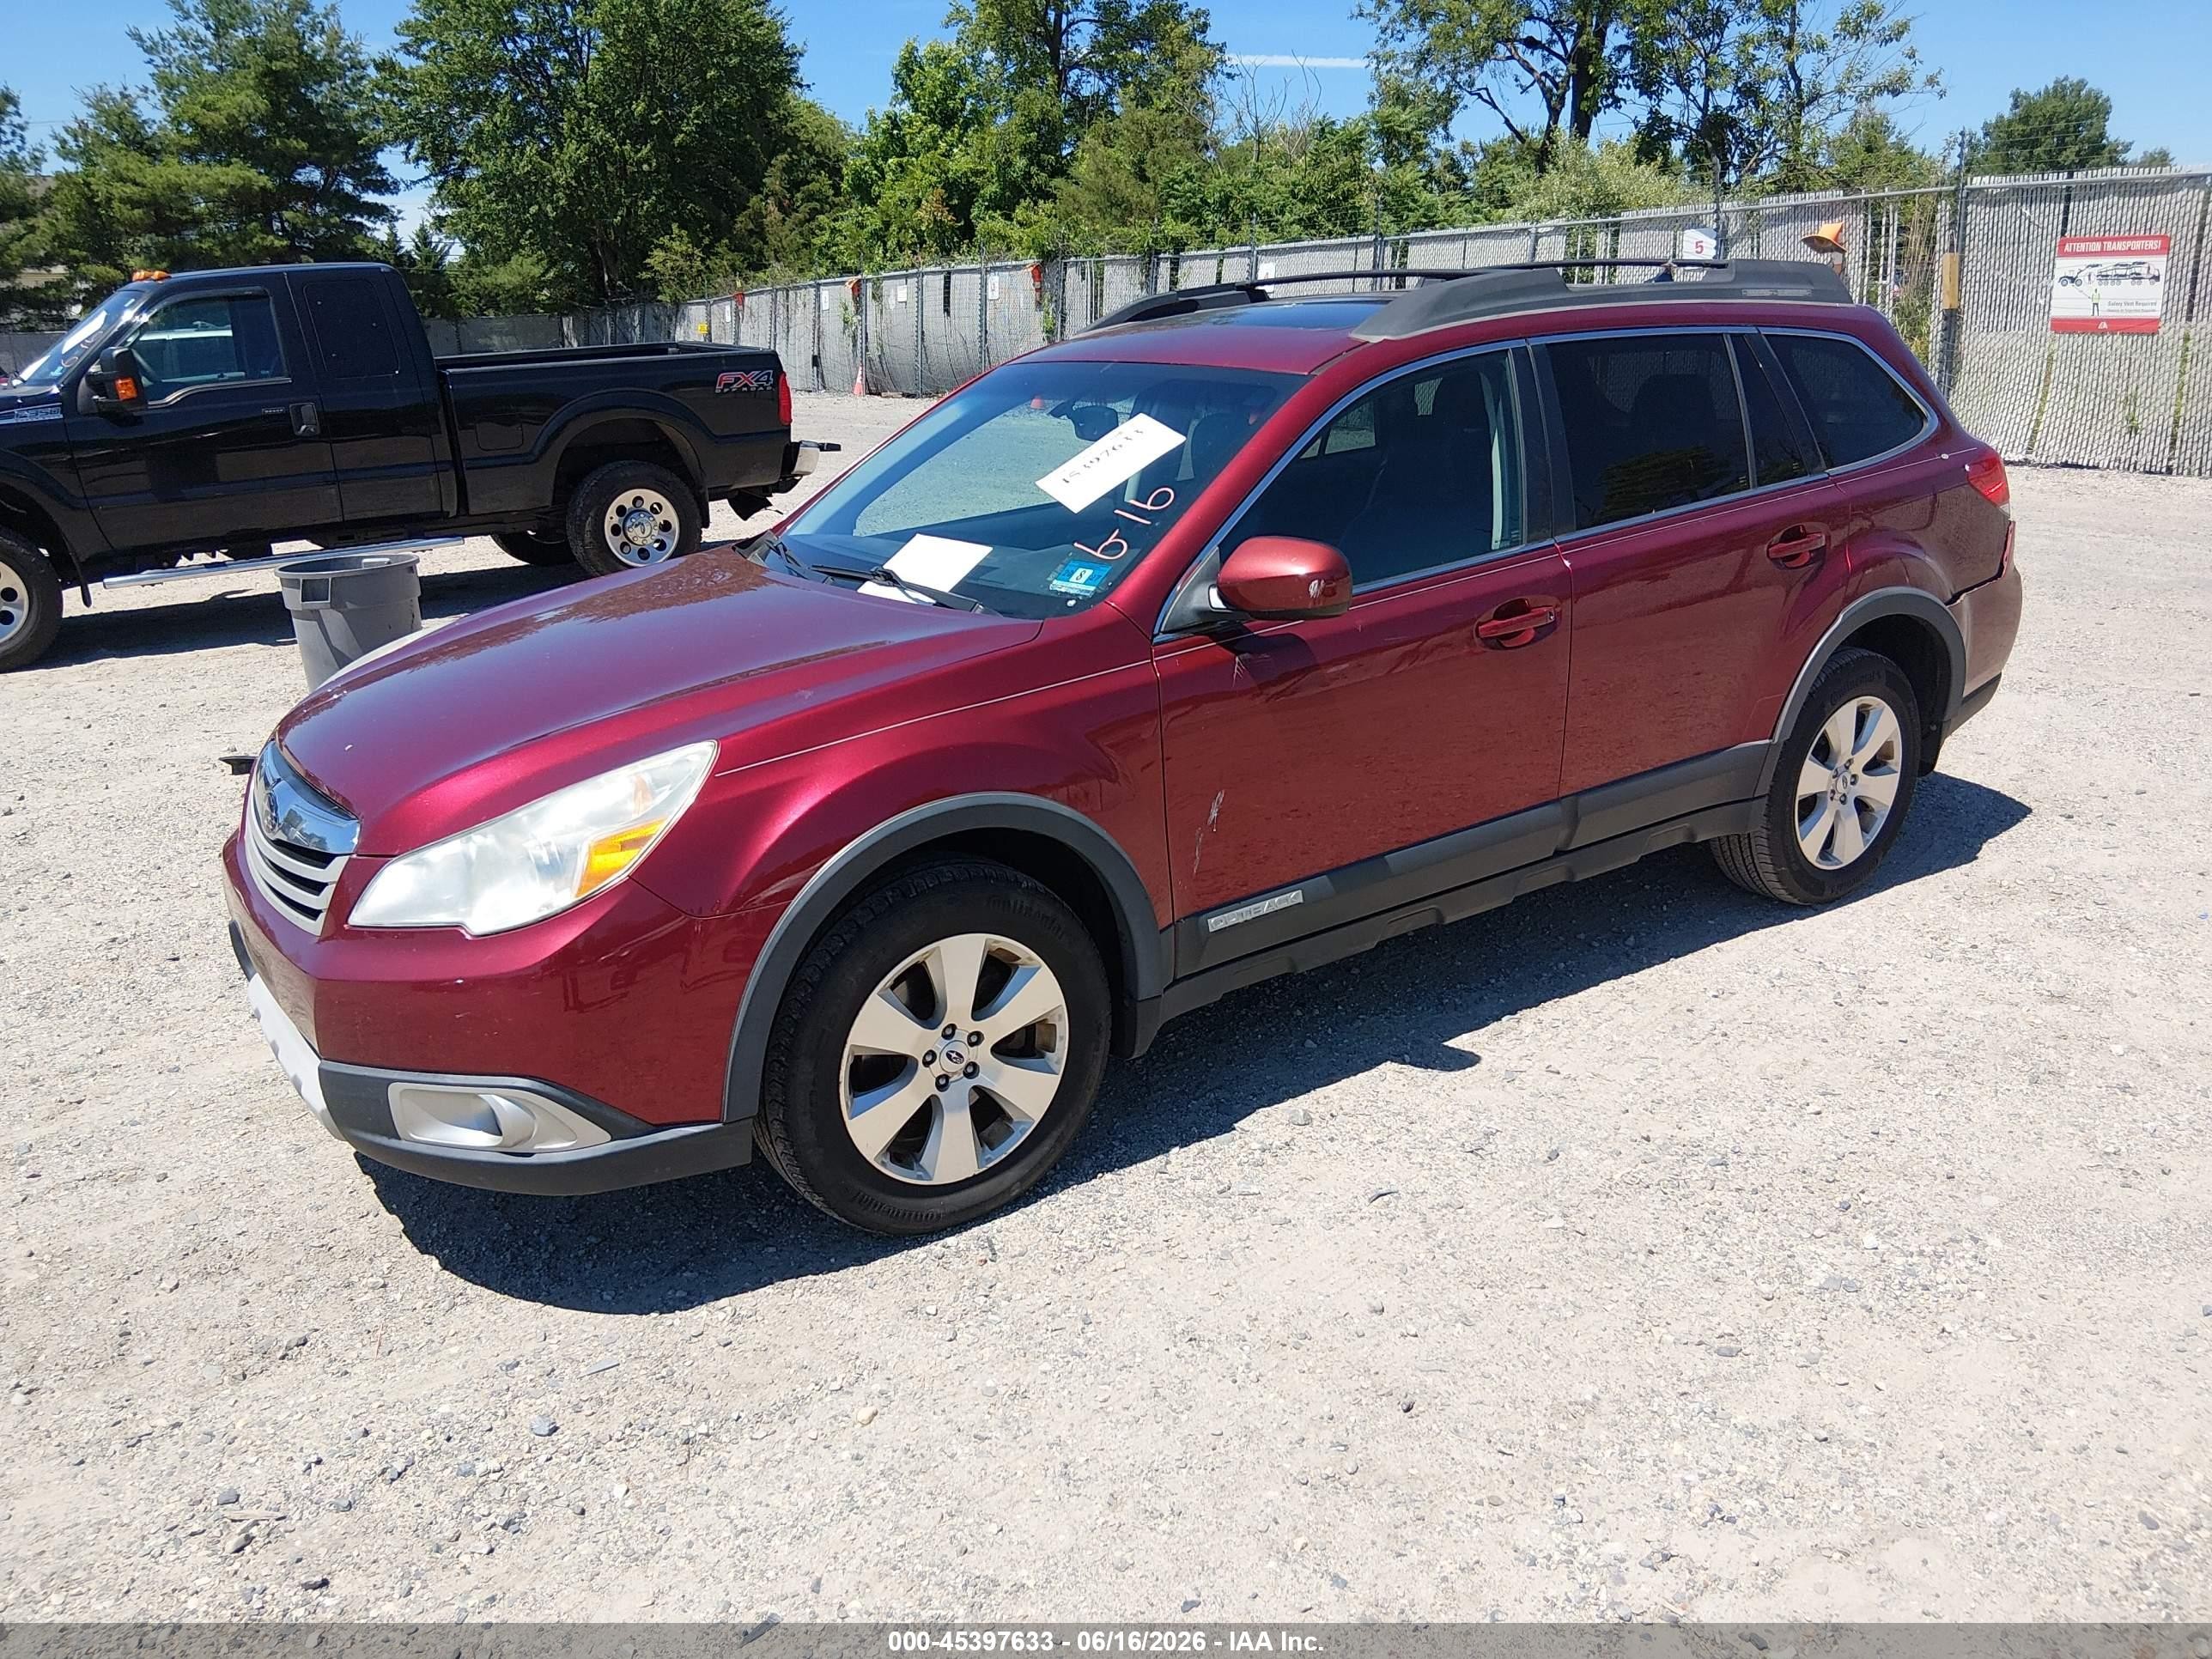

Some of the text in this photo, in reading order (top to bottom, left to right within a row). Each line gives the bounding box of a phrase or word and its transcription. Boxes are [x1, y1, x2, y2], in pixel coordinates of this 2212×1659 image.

[1694, 240, 1705, 254] 5
[2064, 240, 2161, 252] ATTENTION TRANSPORTERS!
[715, 370, 774, 389] FX4
